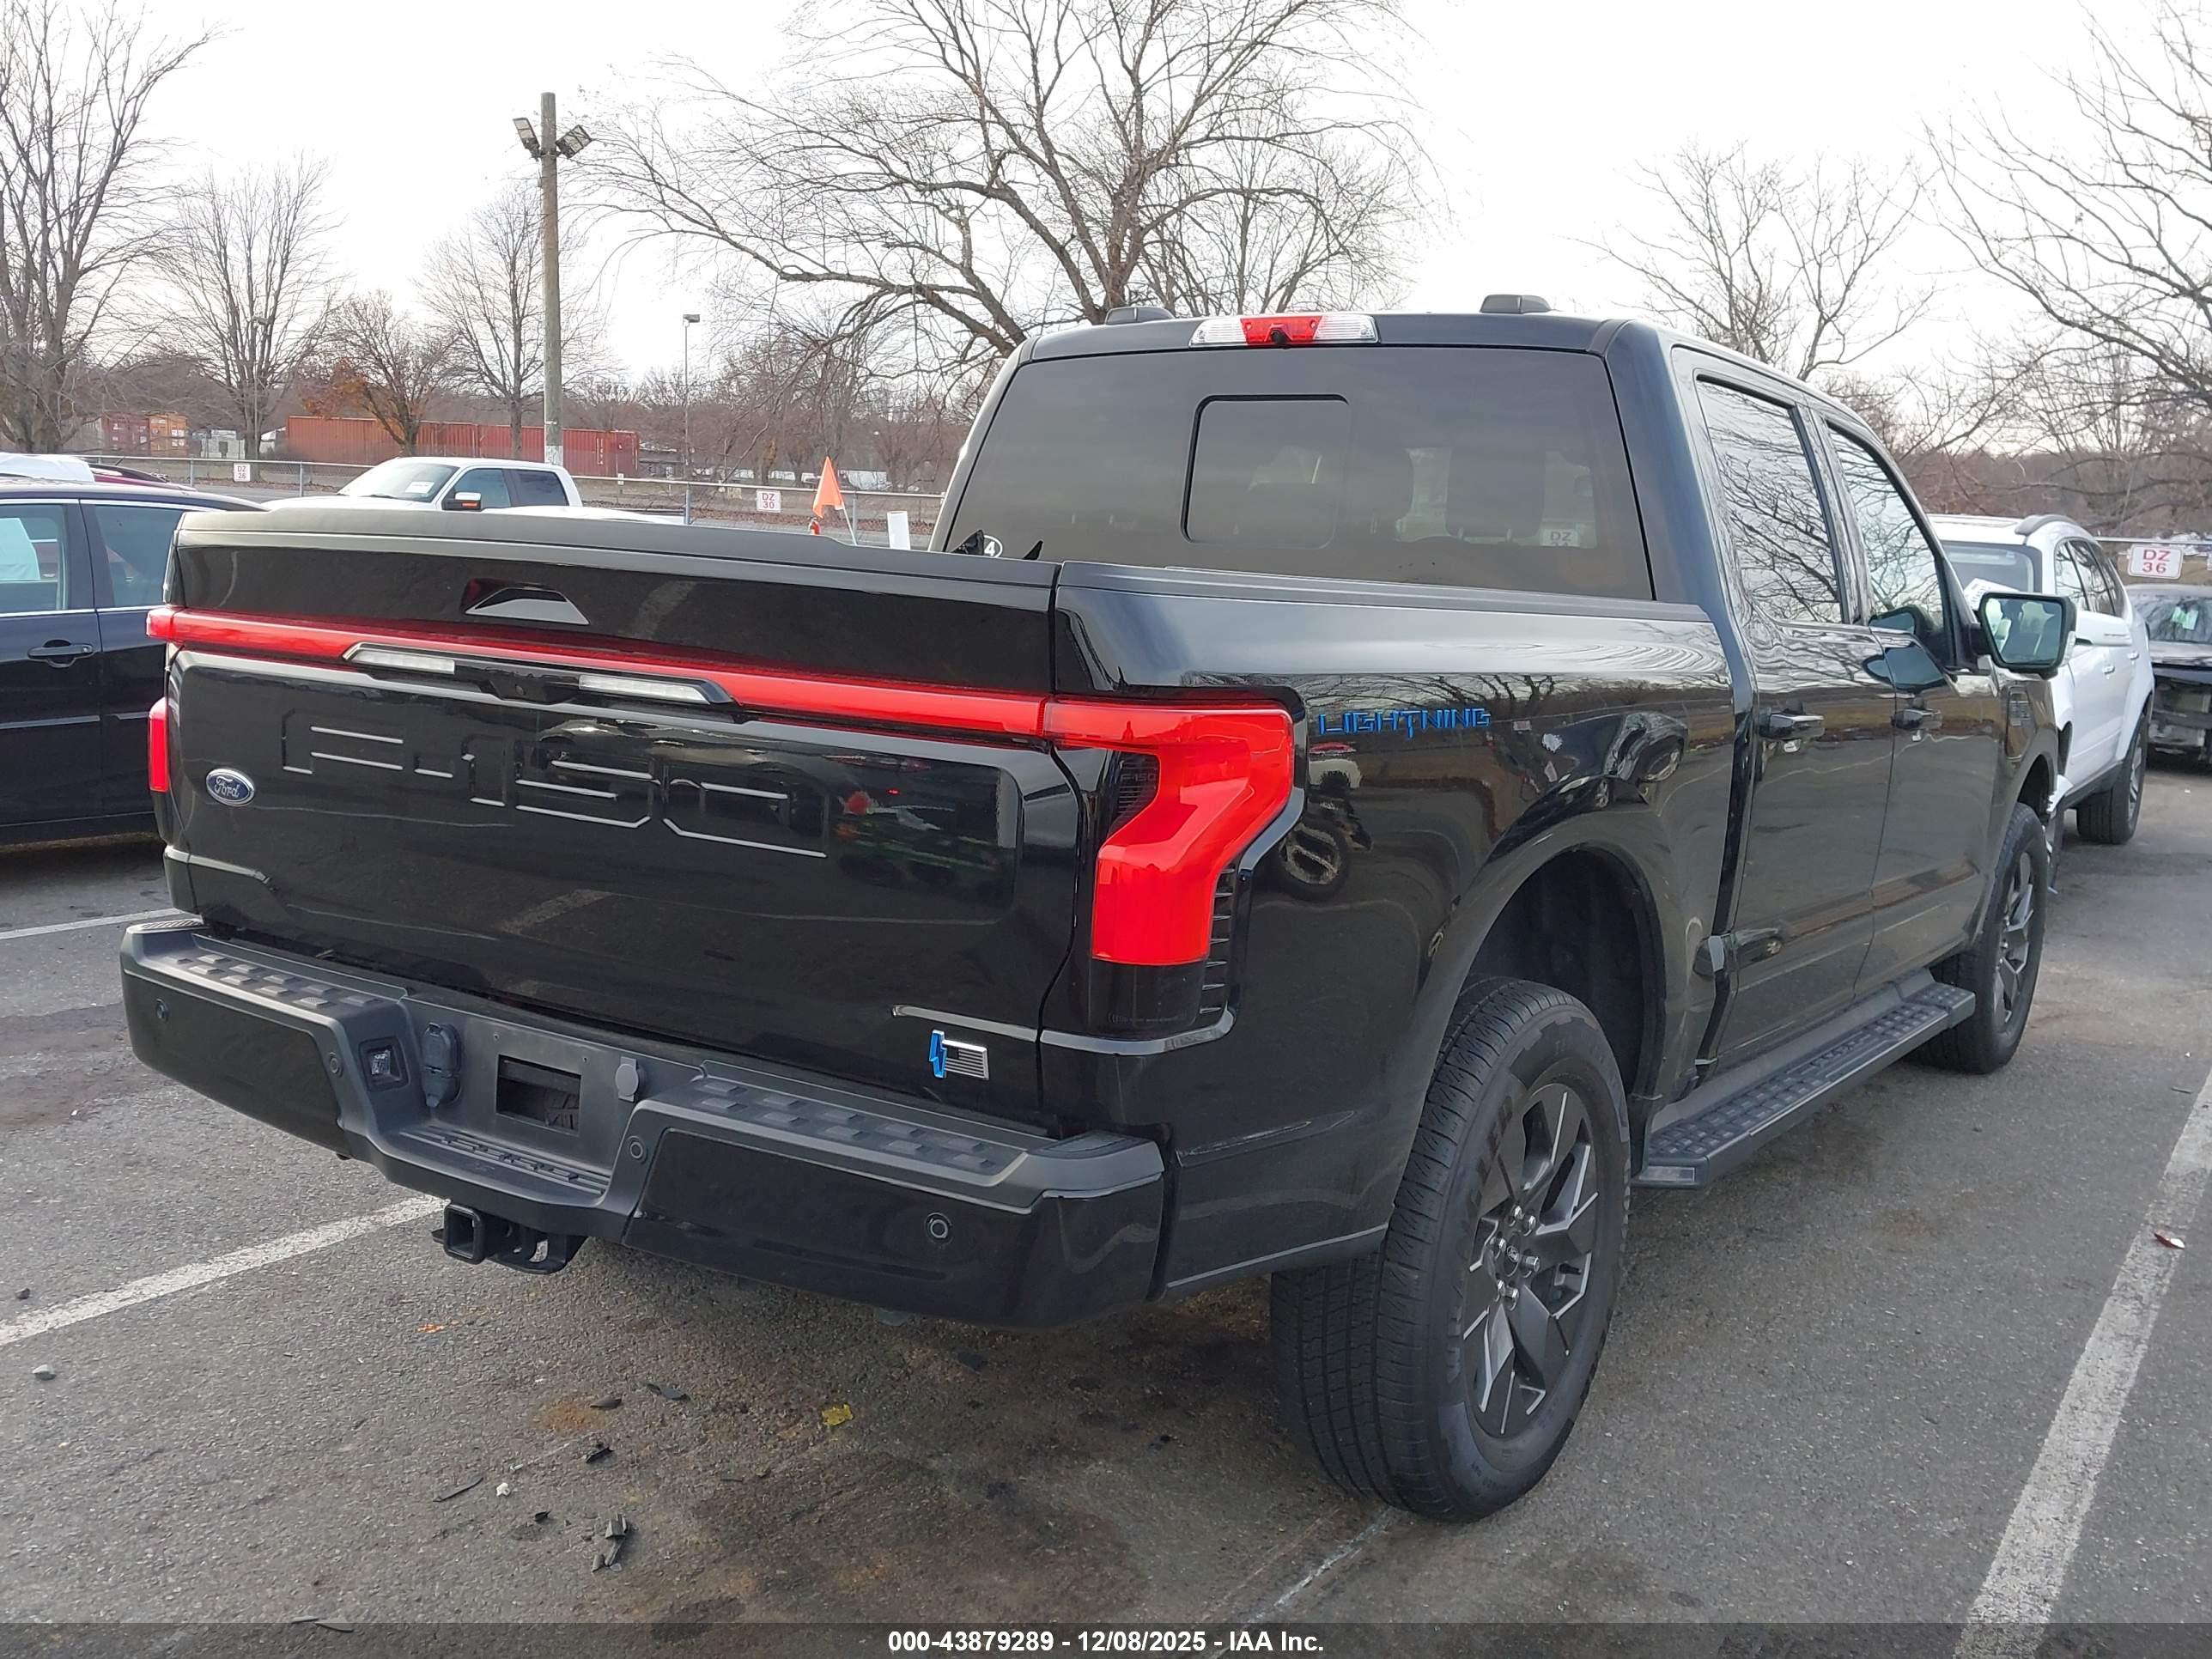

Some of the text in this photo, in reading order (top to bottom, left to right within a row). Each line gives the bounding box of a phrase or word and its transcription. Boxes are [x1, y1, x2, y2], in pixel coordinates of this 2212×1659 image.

[762, 492, 775, 501] DZ
[763, 501, 775, 509] 30
[1550, 531, 1572, 542] DZ
[2143, 549, 2172, 562] DZ
[2142, 562, 2167, 574] 36
[1317, 706, 1492, 739] LIGHTNING
[213, 775, 241, 799] Ford
